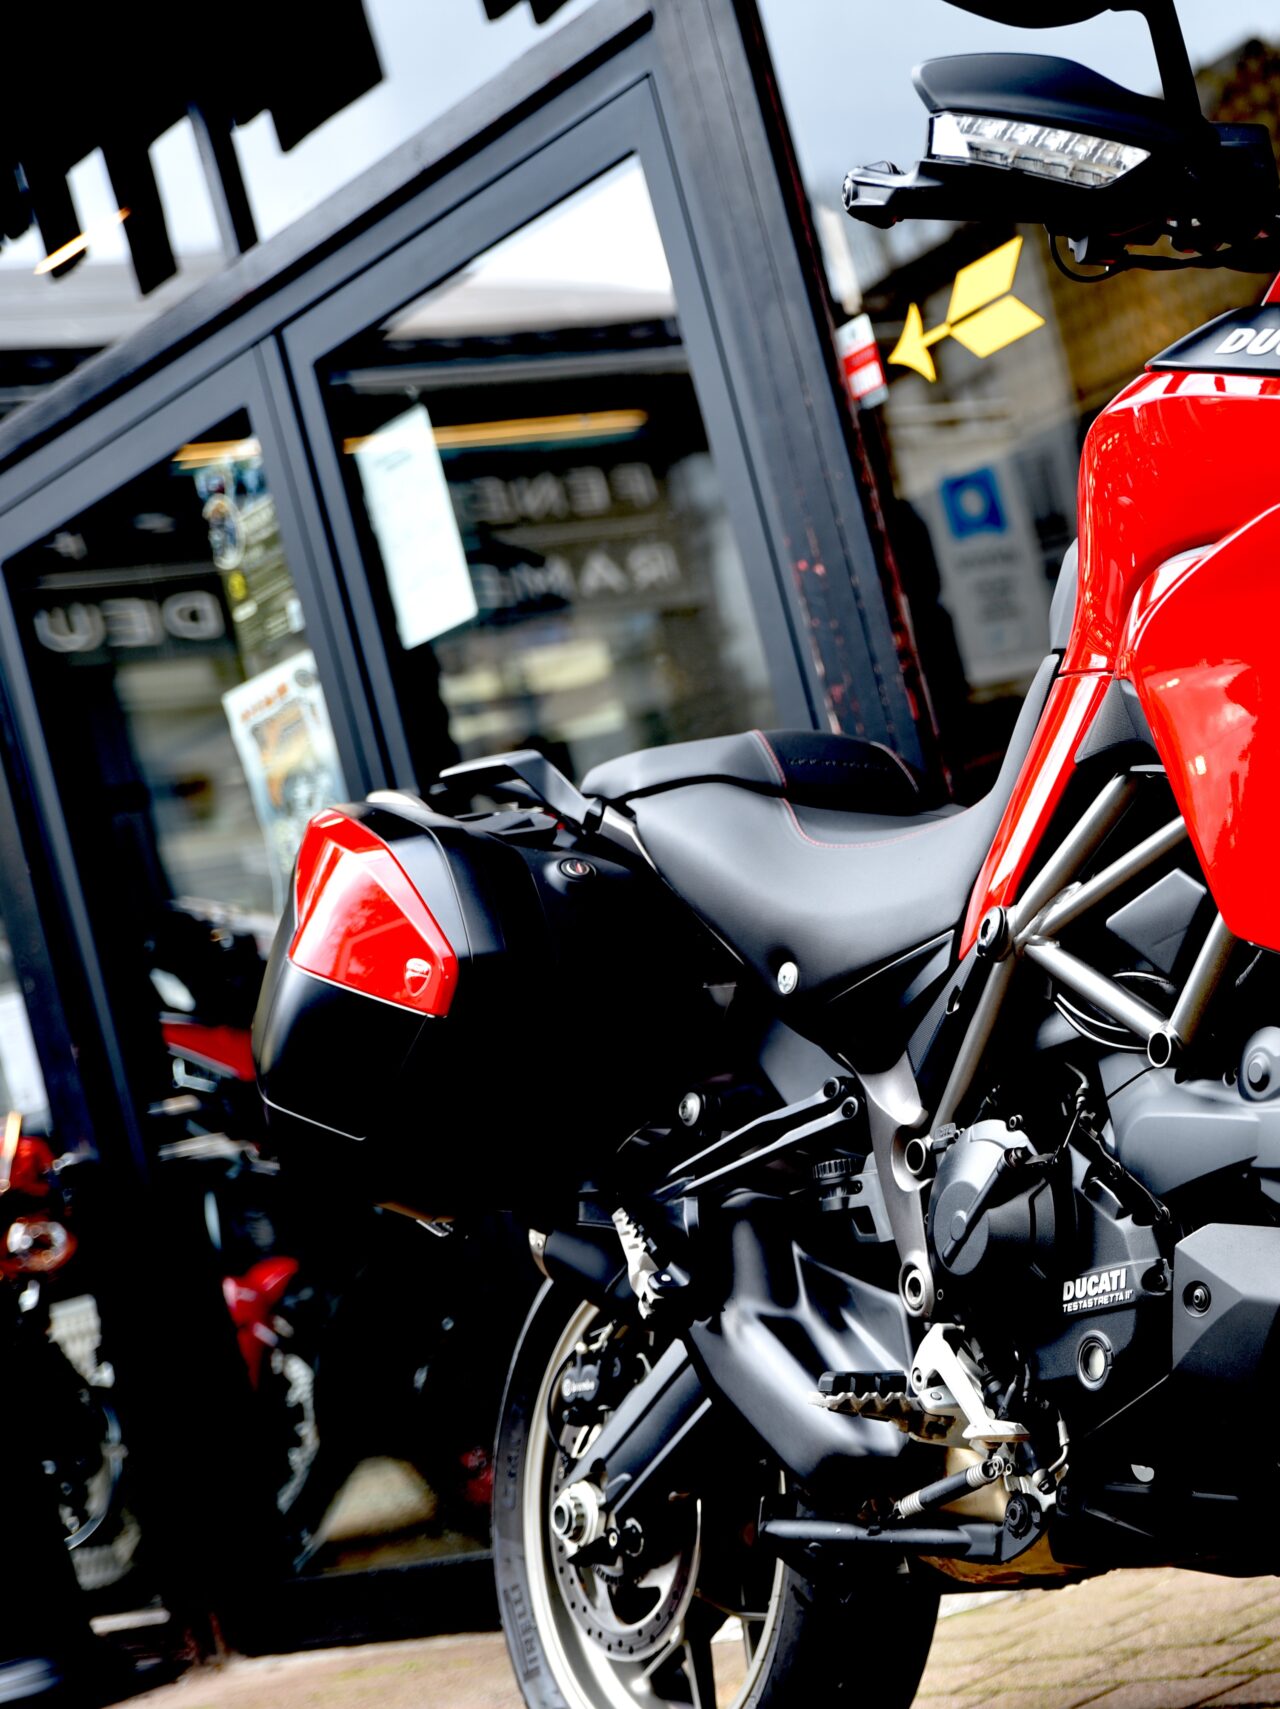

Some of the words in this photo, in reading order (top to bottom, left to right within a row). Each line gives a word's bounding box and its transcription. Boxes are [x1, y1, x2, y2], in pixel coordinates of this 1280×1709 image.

[1062, 1267, 1127, 1301] DUCATI
[1062, 1292, 1124, 1313] TESTASTRETTA
[503, 1582, 541, 1683] PIRELLI
